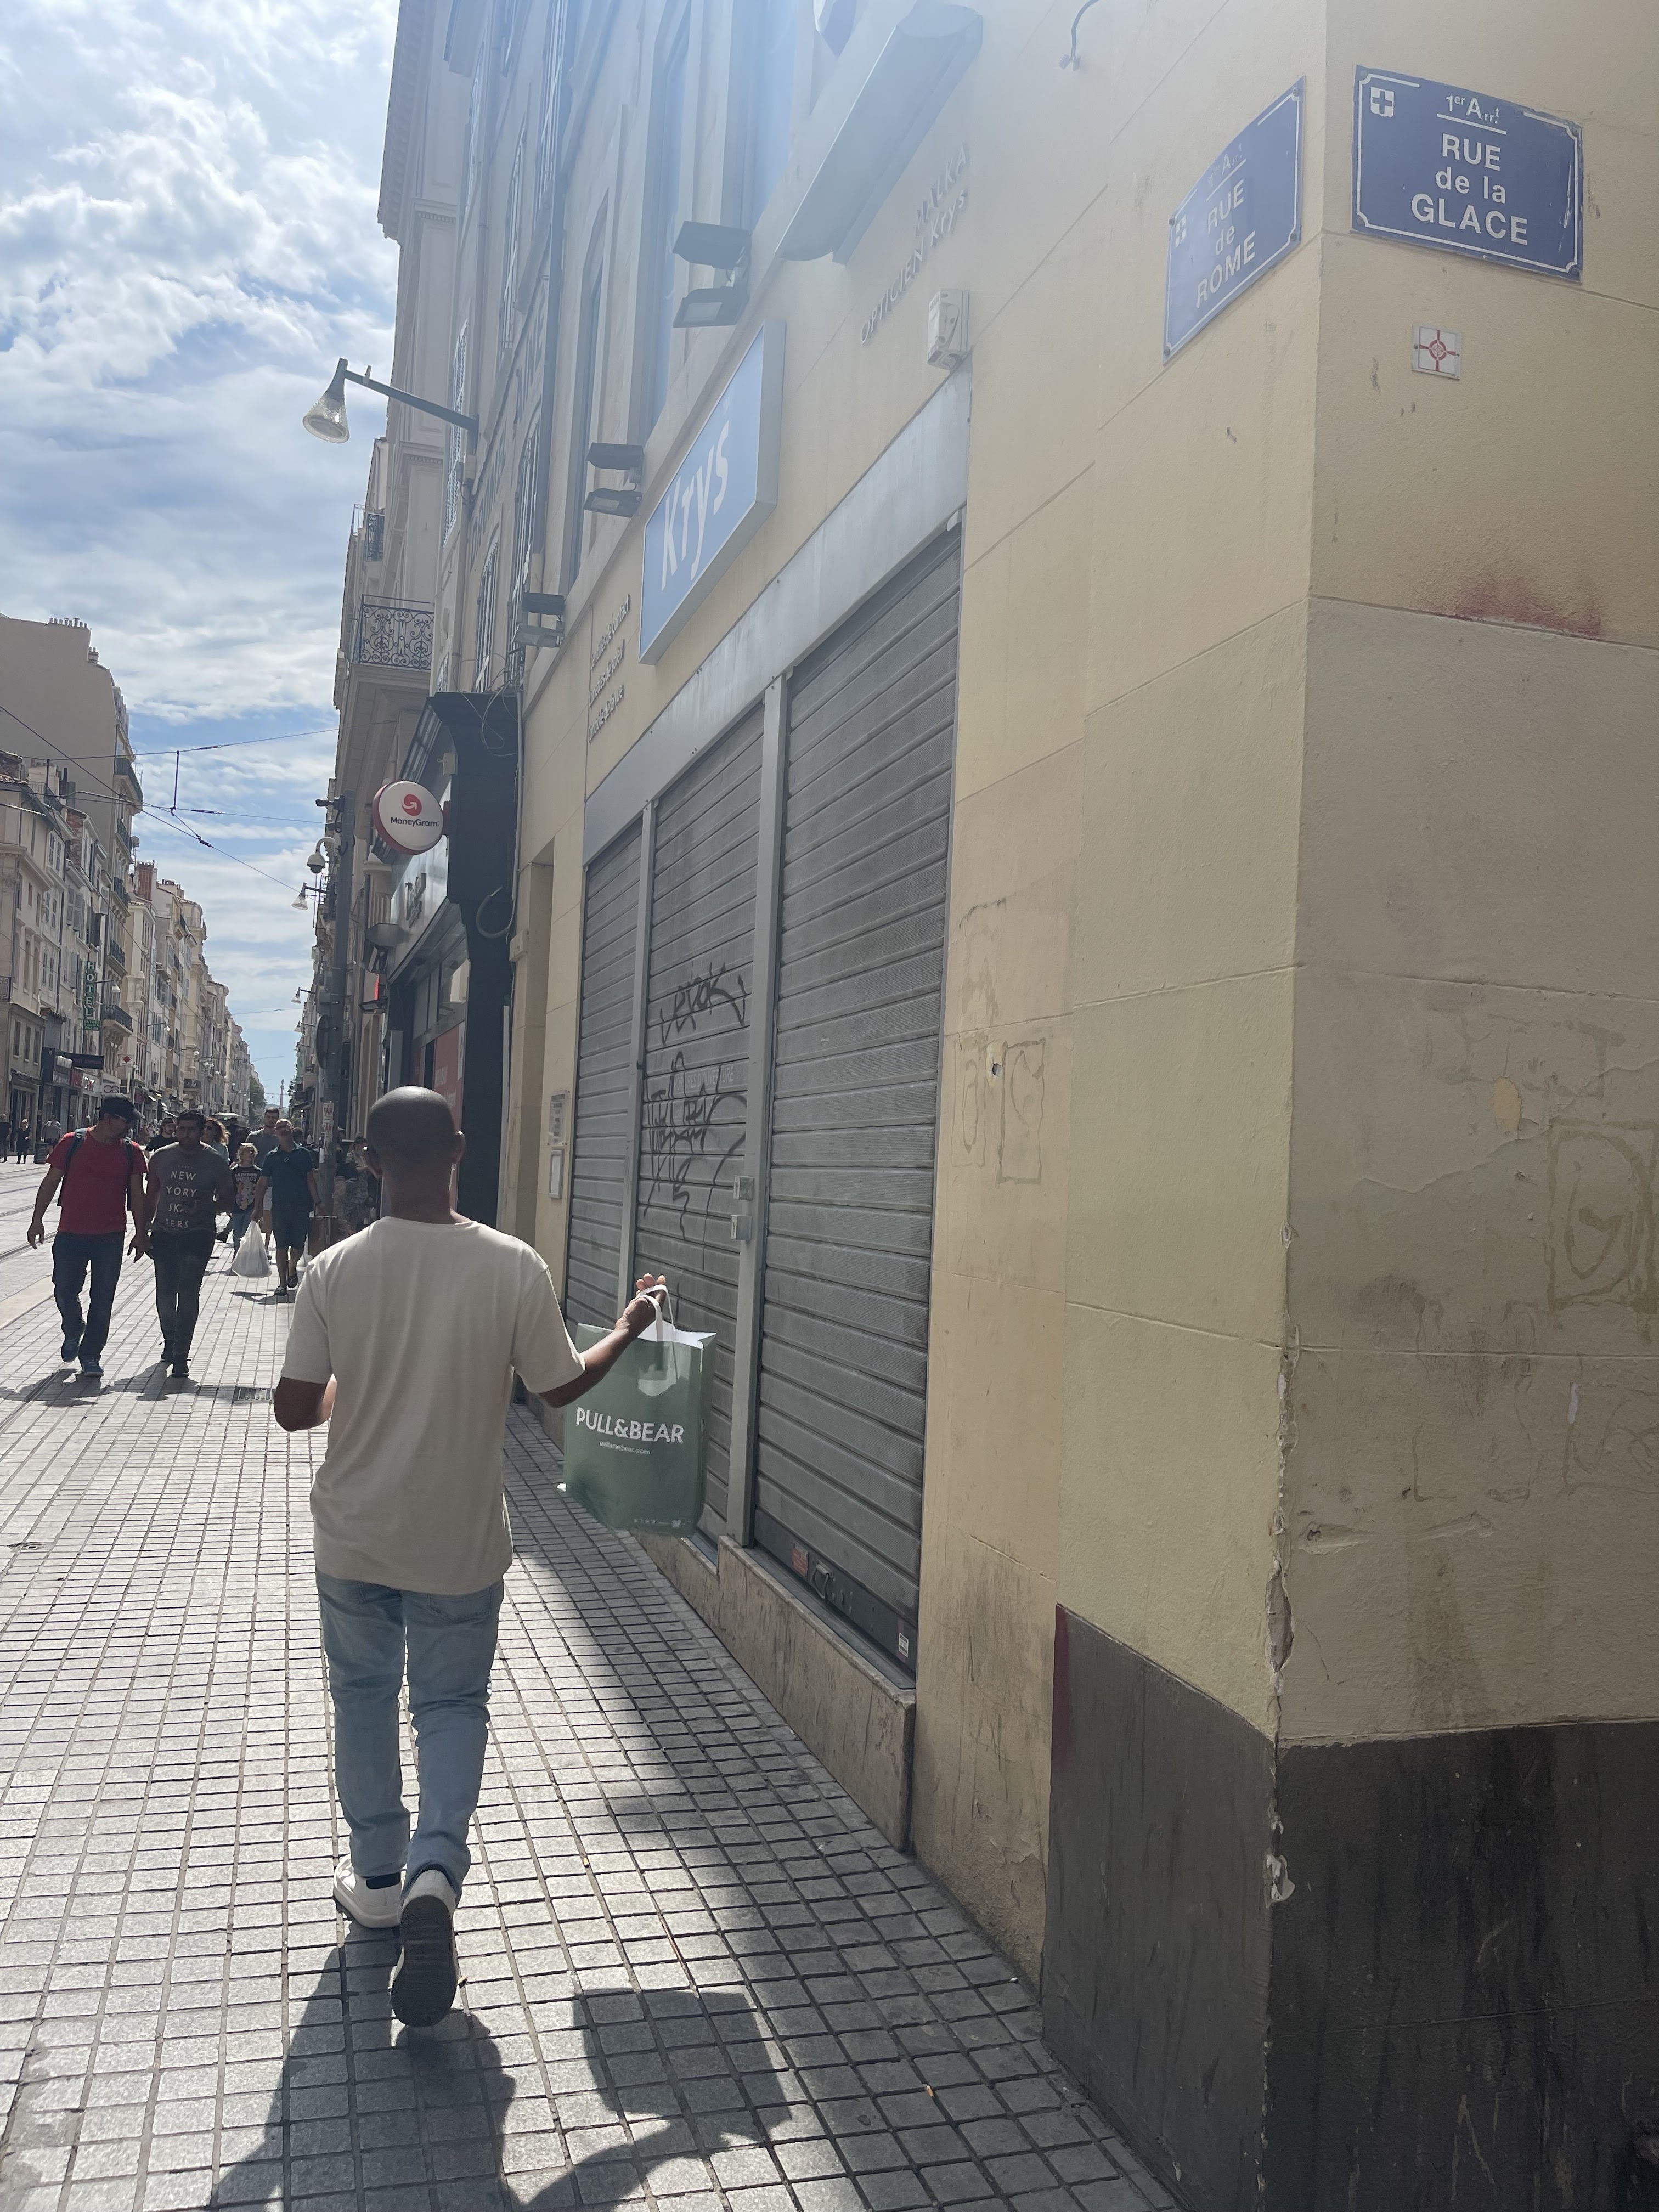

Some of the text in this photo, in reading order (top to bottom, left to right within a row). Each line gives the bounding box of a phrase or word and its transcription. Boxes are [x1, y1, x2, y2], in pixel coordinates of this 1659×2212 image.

[1445, 94, 1466, 112] 1er
[1442, 133, 1501, 172] RUE
[914, 141, 968, 237] MALKA
[1435, 166, 1506, 204] de la
[1207, 178, 1245, 235] RUE
[1411, 193, 1528, 246] GLACE
[1215, 224, 1235, 256] de
[1196, 230, 1256, 309] ROME
[860, 236, 924, 345] OPTICIEN
[614, 684, 624, 706] vue
[390, 816, 438, 827] MoneyGram
[85, 961, 95, 1017] HOTEL
[170, 1170, 196, 1181] NEW
[576, 1407, 684, 1443] PULL&BEAR
